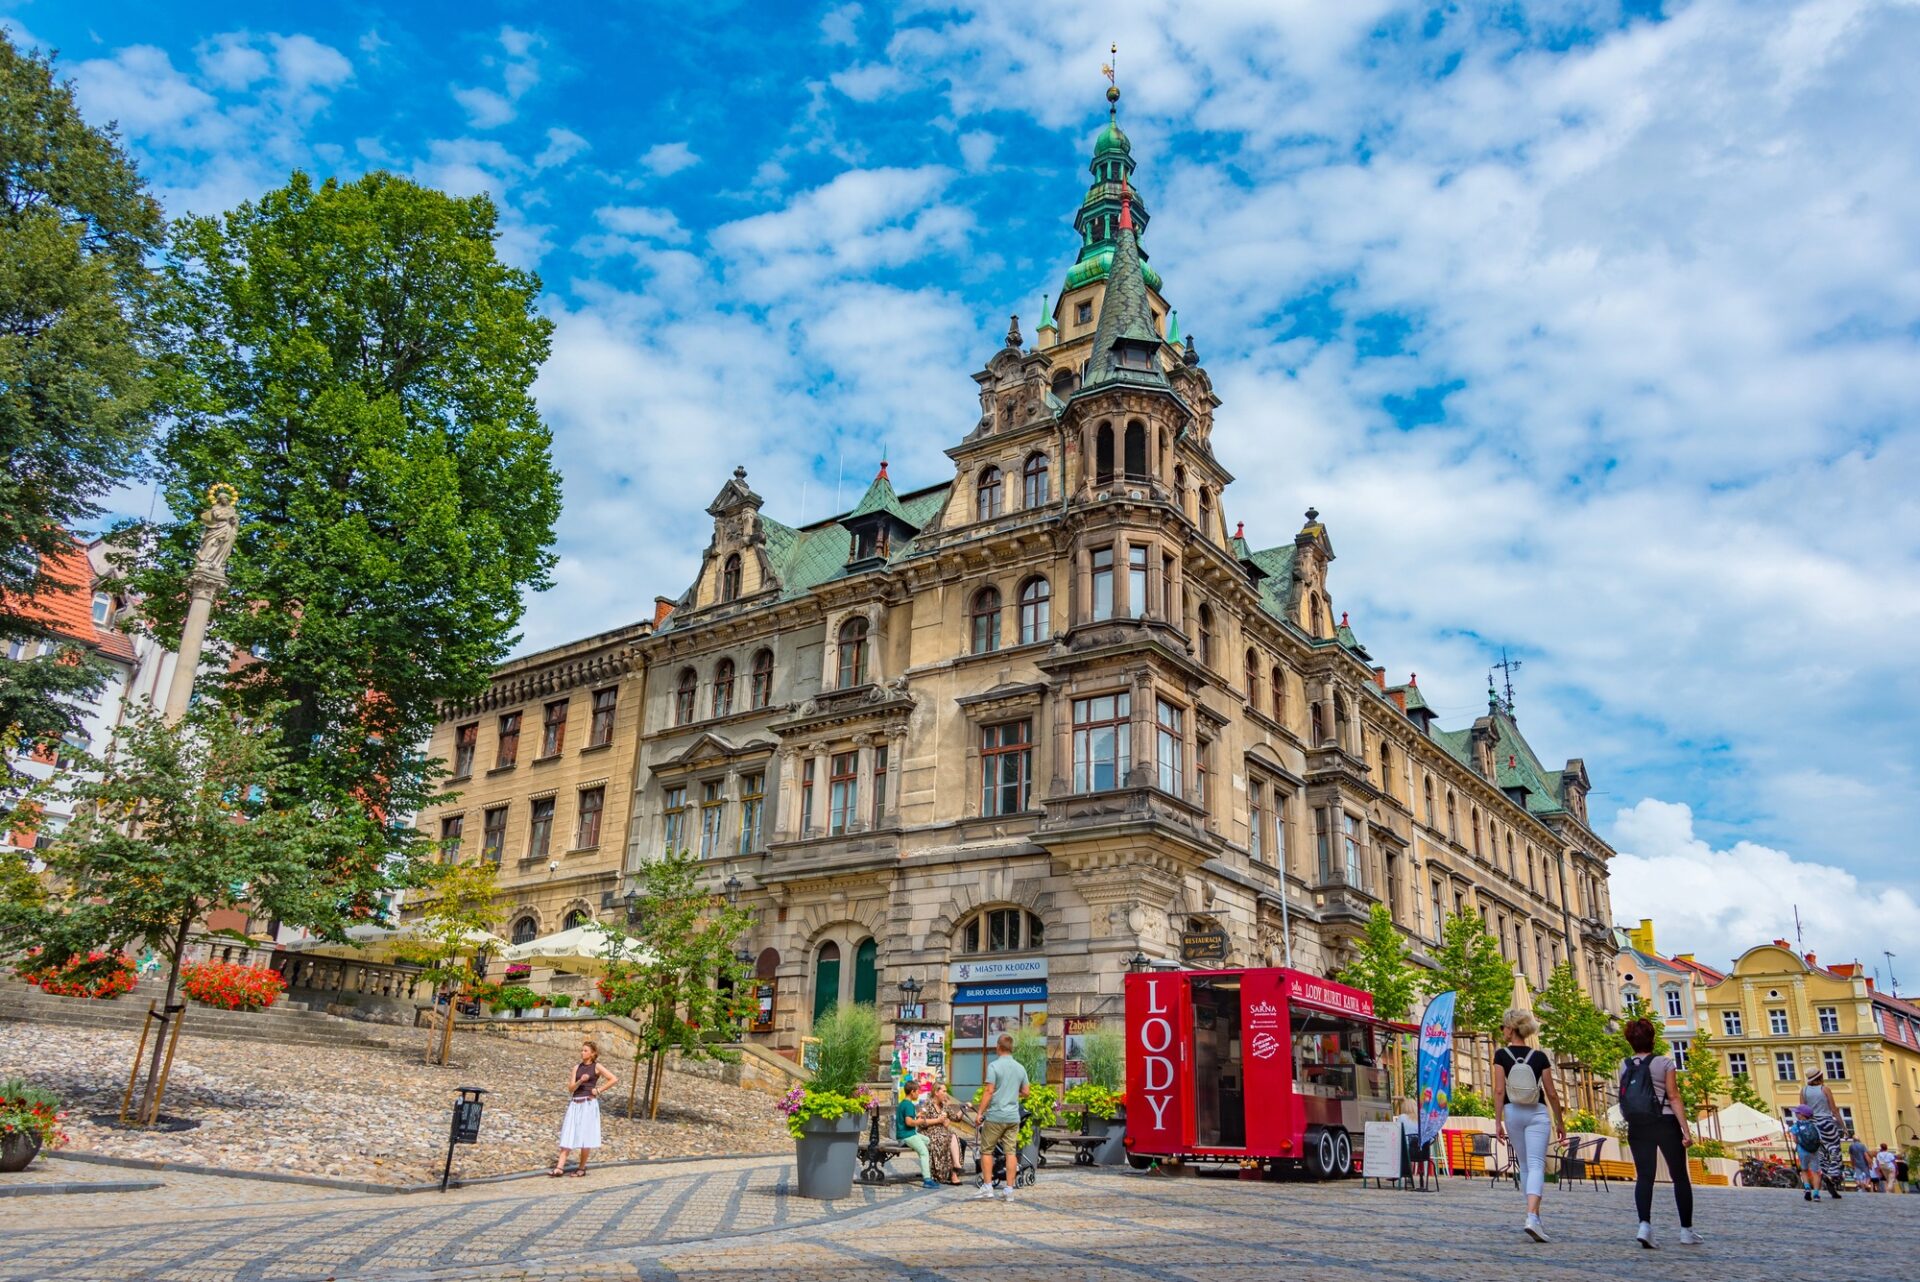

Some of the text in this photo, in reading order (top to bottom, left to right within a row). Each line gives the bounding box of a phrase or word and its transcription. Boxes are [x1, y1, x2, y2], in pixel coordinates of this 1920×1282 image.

[1184, 936, 1222, 945] RESTAURACJA
[975, 962, 1040, 973] MIASTO KŁODZKO
[966, 989, 985, 997] BIURO
[1012, 986, 1042, 995] LUDNOŚCI
[1305, 983, 1360, 1012] LODY RURKI KAWA
[1250, 1004, 1277, 1014] SARNA
[1068, 1020, 1097, 1033] Zabytki
[1141, 980, 1174, 1130] LODY
[1747, 1134, 1770, 1145] TYSKIE
